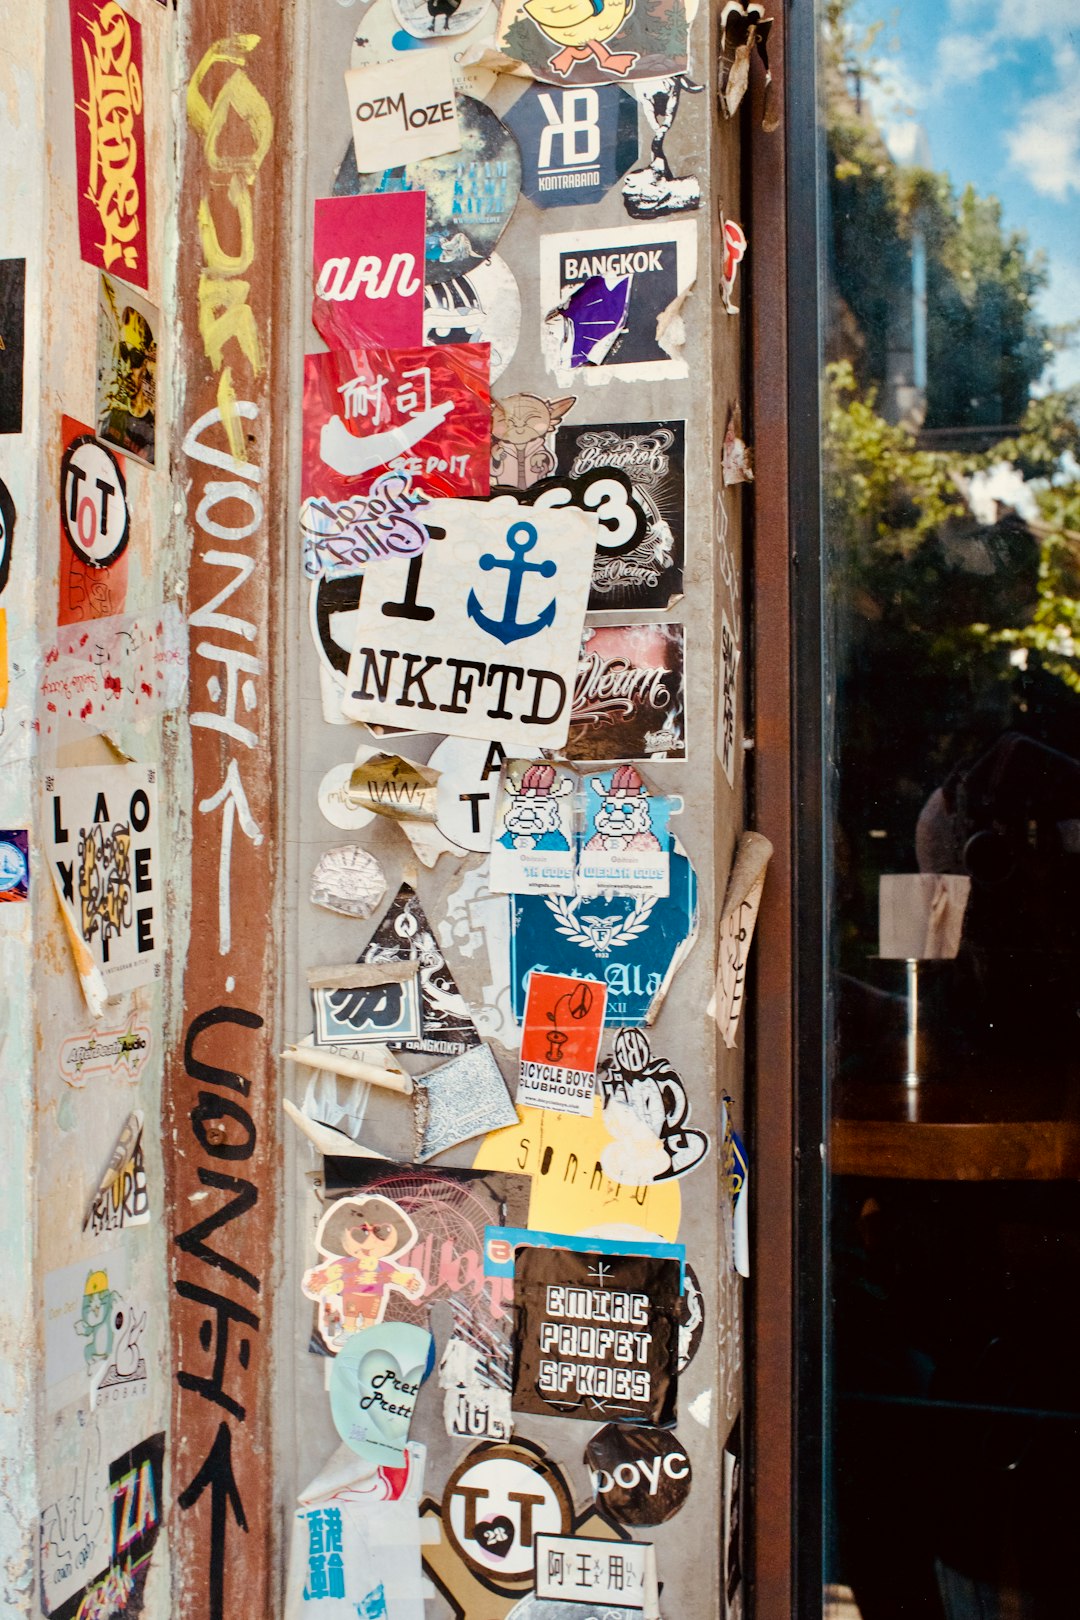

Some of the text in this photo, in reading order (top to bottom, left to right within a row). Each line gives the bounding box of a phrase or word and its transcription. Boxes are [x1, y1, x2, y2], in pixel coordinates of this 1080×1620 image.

[538, 171, 601, 191] KONTRABAND
[565, 249, 663, 280] BANGKOK
[352, 647, 567, 725] NKFTD
[459, 793, 490, 833] T
[519, 1078, 592, 1100] CLUBHOUSE
[520, 1061, 595, 1089] BICYCLE BOYS
[483, 1526, 509, 1546] 28
